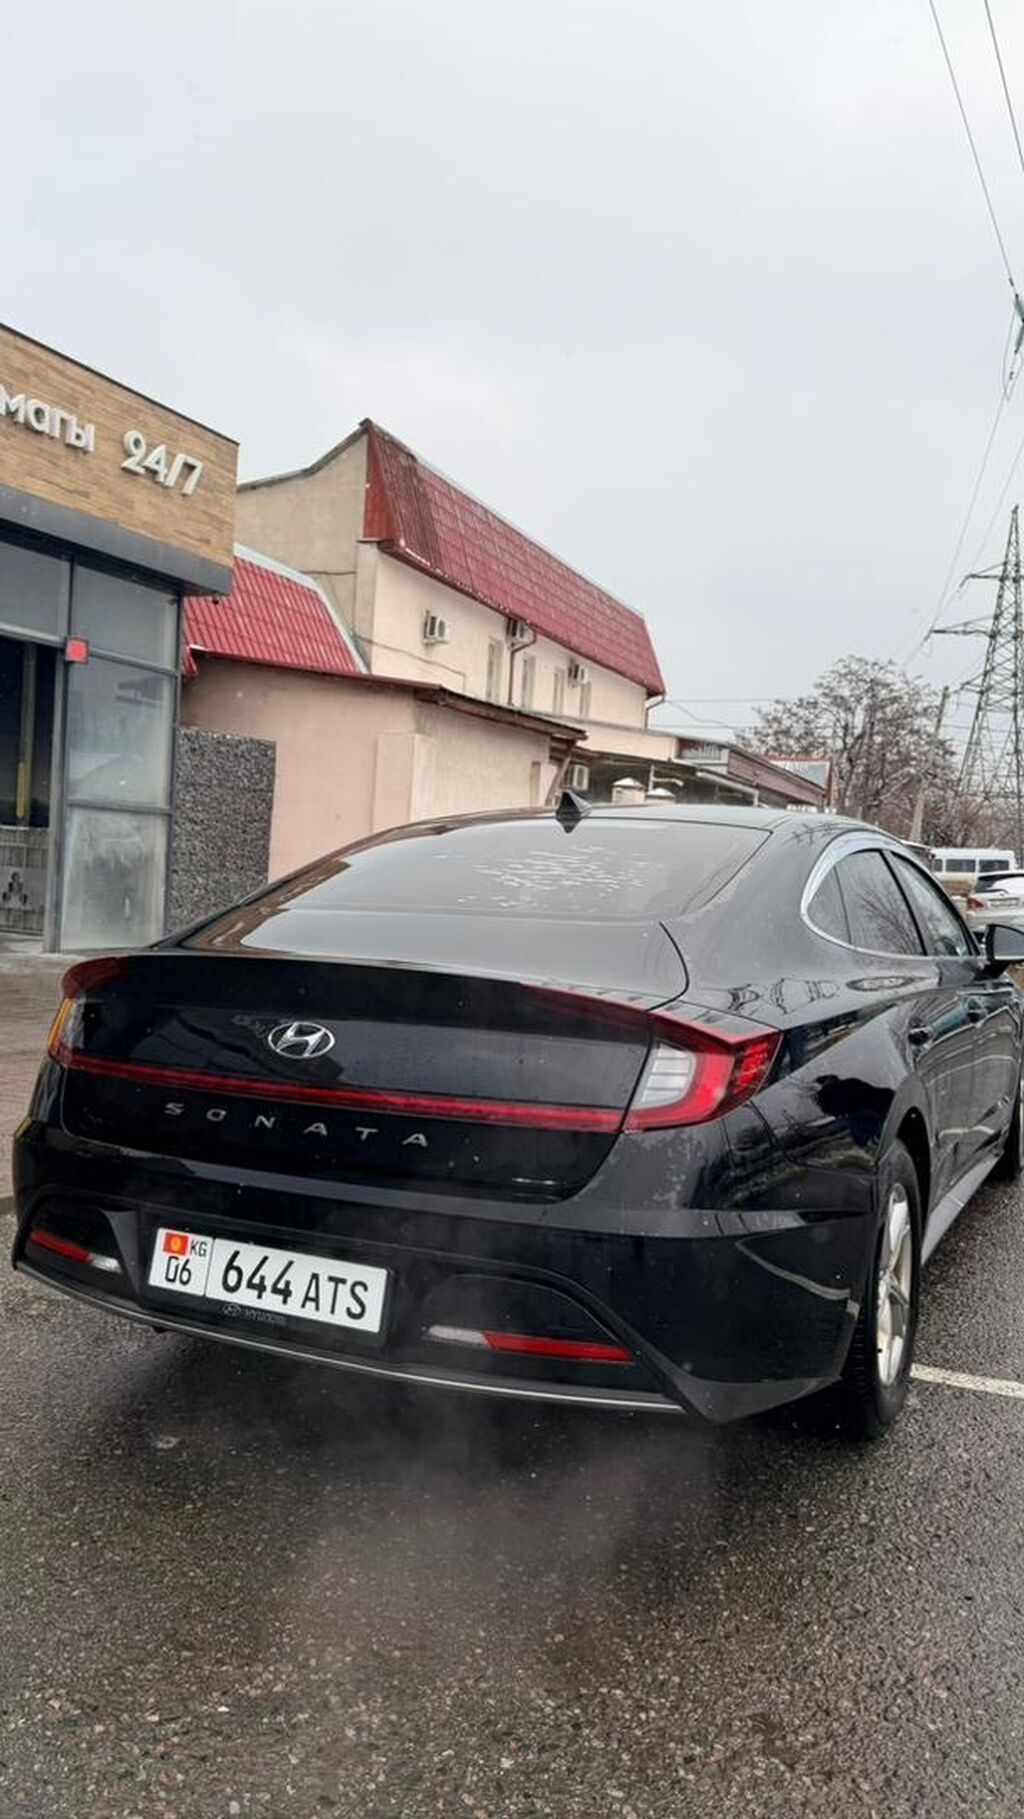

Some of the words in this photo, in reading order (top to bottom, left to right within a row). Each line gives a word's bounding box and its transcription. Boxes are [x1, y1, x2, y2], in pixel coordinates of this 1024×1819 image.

[121, 430, 203, 496] 24/7
[164, 1102, 429, 1147] SONATA
[164, 1255, 193, 1286] 06
[189, 1239, 208, 1258] KG
[221, 1250, 295, 1305] 644
[301, 1272, 370, 1320] ATS
